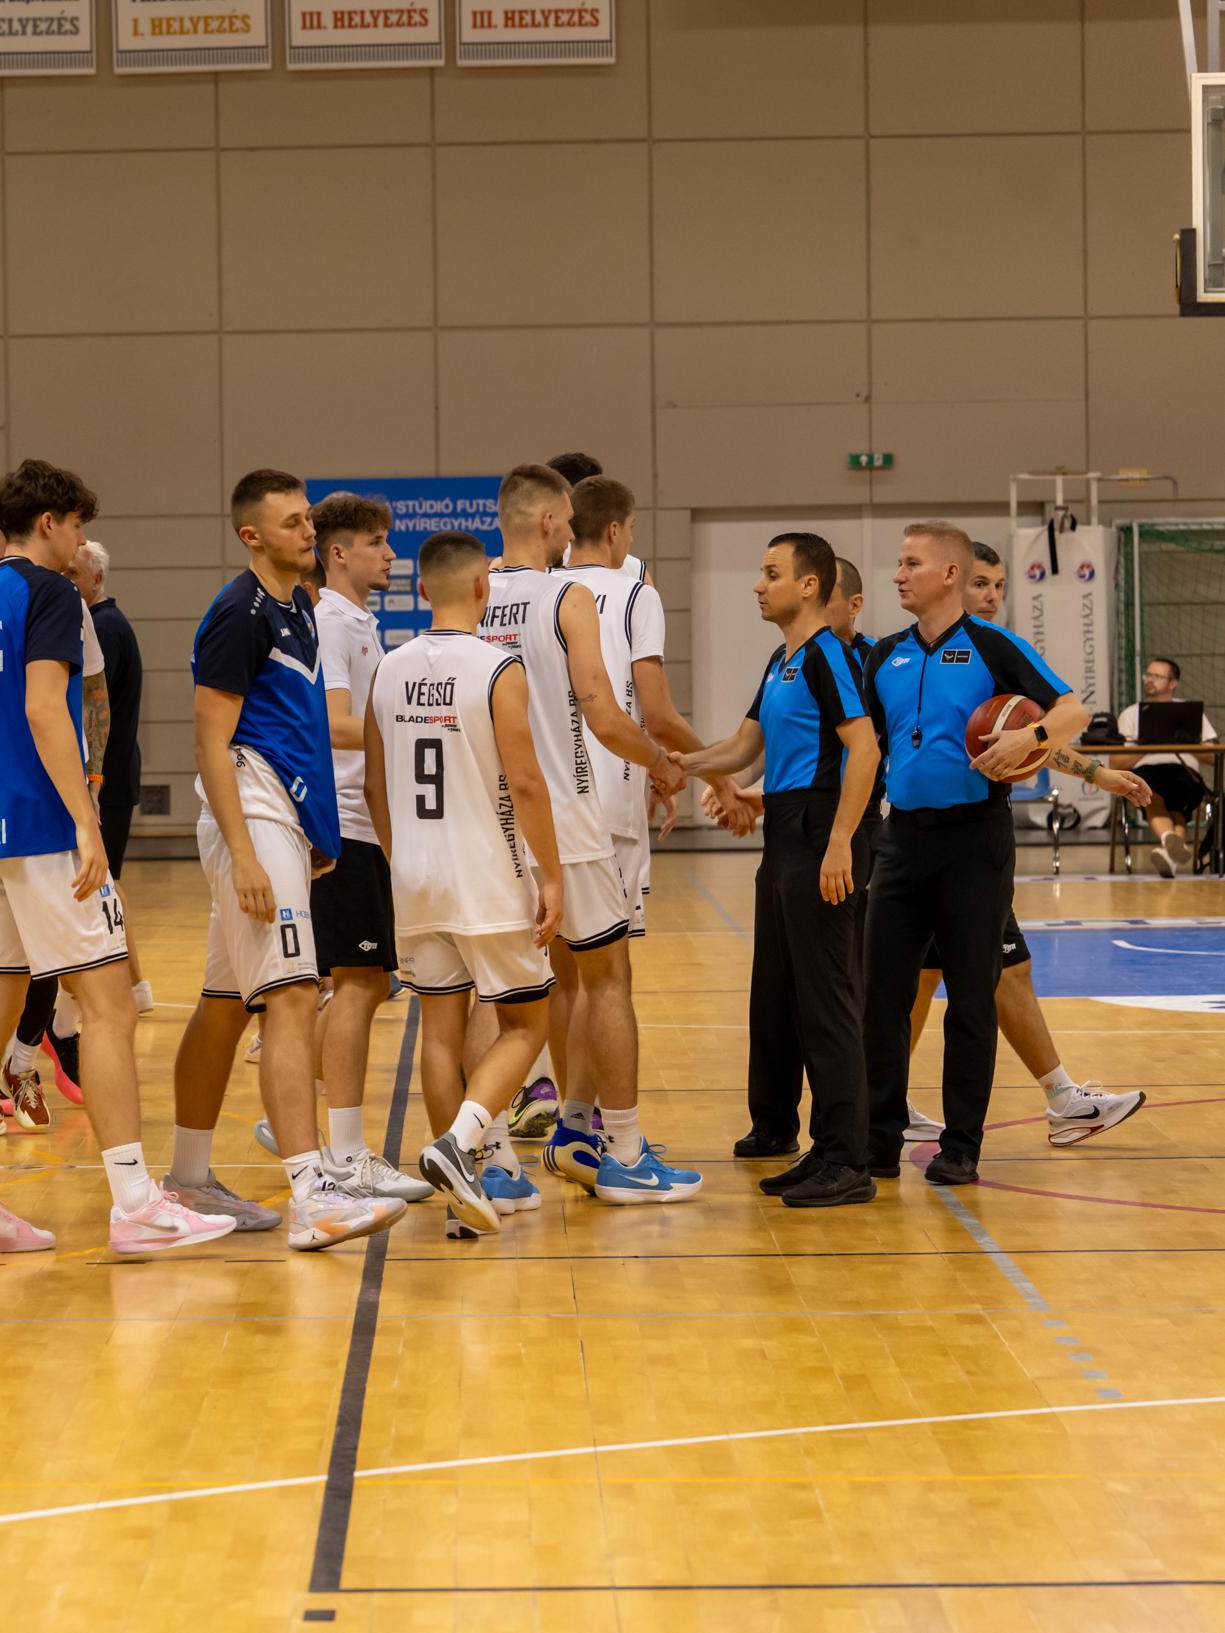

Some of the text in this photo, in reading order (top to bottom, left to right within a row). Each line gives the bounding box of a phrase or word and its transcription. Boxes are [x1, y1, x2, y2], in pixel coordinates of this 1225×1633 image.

[132, 8, 252, 36] I. HELYEZÉS
[301, 2, 429, 30] III. HELYEZÉS
[472, 1, 600, 29] III. HELYEZÉS
[456, 500, 499, 512] FUTS
[395, 515, 501, 531] NYÍREGYHÁZA
[405, 677, 456, 707] VÉGSŐ
[626, 680, 633, 697] BS
[395, 715, 457, 724] BLADESPORT
[571, 711, 590, 794] NYÍREGYHÁZA
[414, 738, 444, 820] 9
[497, 795, 524, 878] NYÍREGYHÁZA
[102, 898, 124, 934] 14
[280, 924, 300, 958] 0
